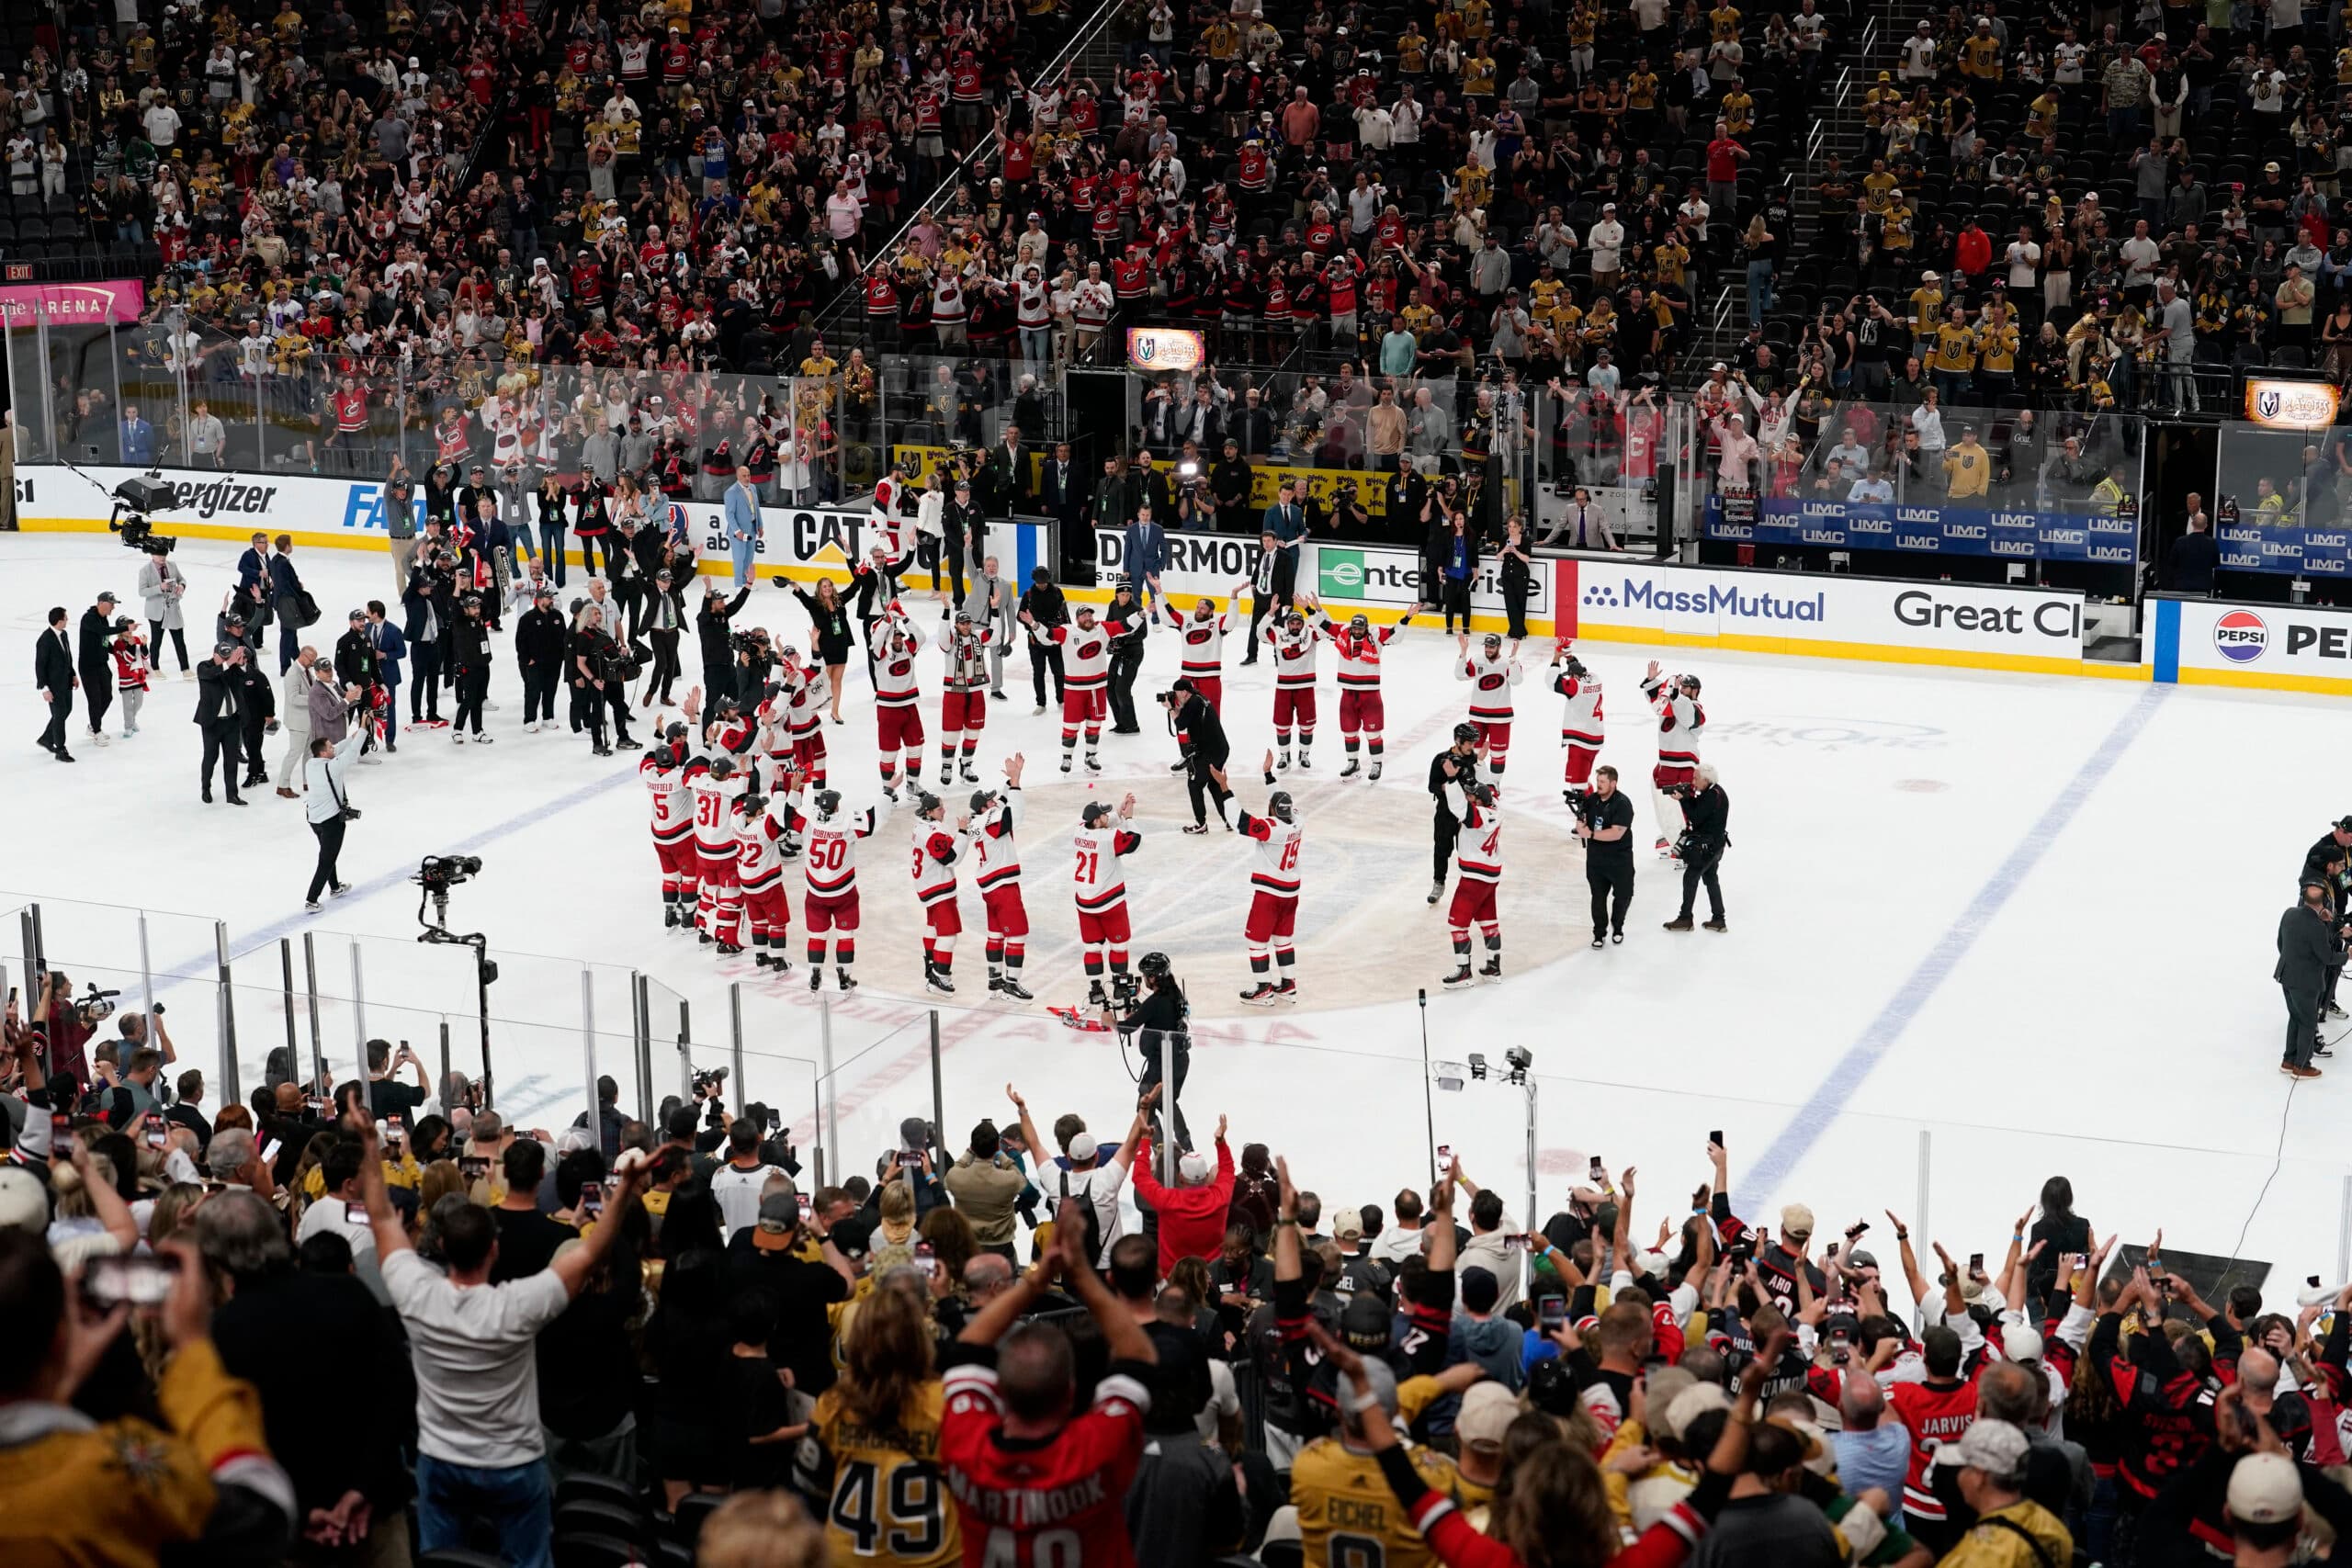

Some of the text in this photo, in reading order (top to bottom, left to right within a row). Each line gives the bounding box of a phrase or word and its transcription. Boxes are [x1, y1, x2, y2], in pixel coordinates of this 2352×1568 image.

[10, 266, 29, 278] EXIT
[1083, 288, 1104, 314] CANES
[1803, 502, 1846, 517] UMC
[1896, 507, 1939, 523] UMC
[1849, 518, 1892, 533] UMC
[1991, 513, 2036, 528] UMC
[2087, 518, 2132, 534] UMC
[793, 513, 865, 563] CAT
[1711, 524, 1753, 538] UMC
[1802, 529, 1845, 544] UMC
[1943, 524, 1987, 539] UMC
[2039, 529, 2084, 544] UMC
[2220, 528, 2262, 542] UMC
[707, 532, 765, 554] abe
[1895, 535, 1939, 549] UMC
[1990, 540, 2035, 556] UMC
[2304, 533, 2346, 547] UMC
[2086, 546, 2132, 561] UMC
[2262, 543, 2303, 558] UMC
[2220, 553, 2260, 567] UMC
[2303, 558, 2346, 572] UMC
[1624, 578, 1825, 622] MassMutual
[1894, 590, 2022, 634] Great
[2217, 629, 2265, 644] PEPSI
[2286, 624, 2352, 660] PE
[1592, 694, 1603, 722] 4
[653, 794, 669, 820] 5
[696, 795, 721, 828] 31
[934, 839, 948, 852] 53
[809, 838, 847, 870] 50
[1279, 838, 1302, 872] 19
[1075, 850, 1098, 884] 21
[1768, 1274, 1792, 1294] AHO
[1921, 1414, 1973, 1435] JARVIS
[947, 1463, 1107, 1525] MARTINOOK
[830, 1459, 945, 1559] 49
[1327, 1496, 1386, 1530] EICHEL
